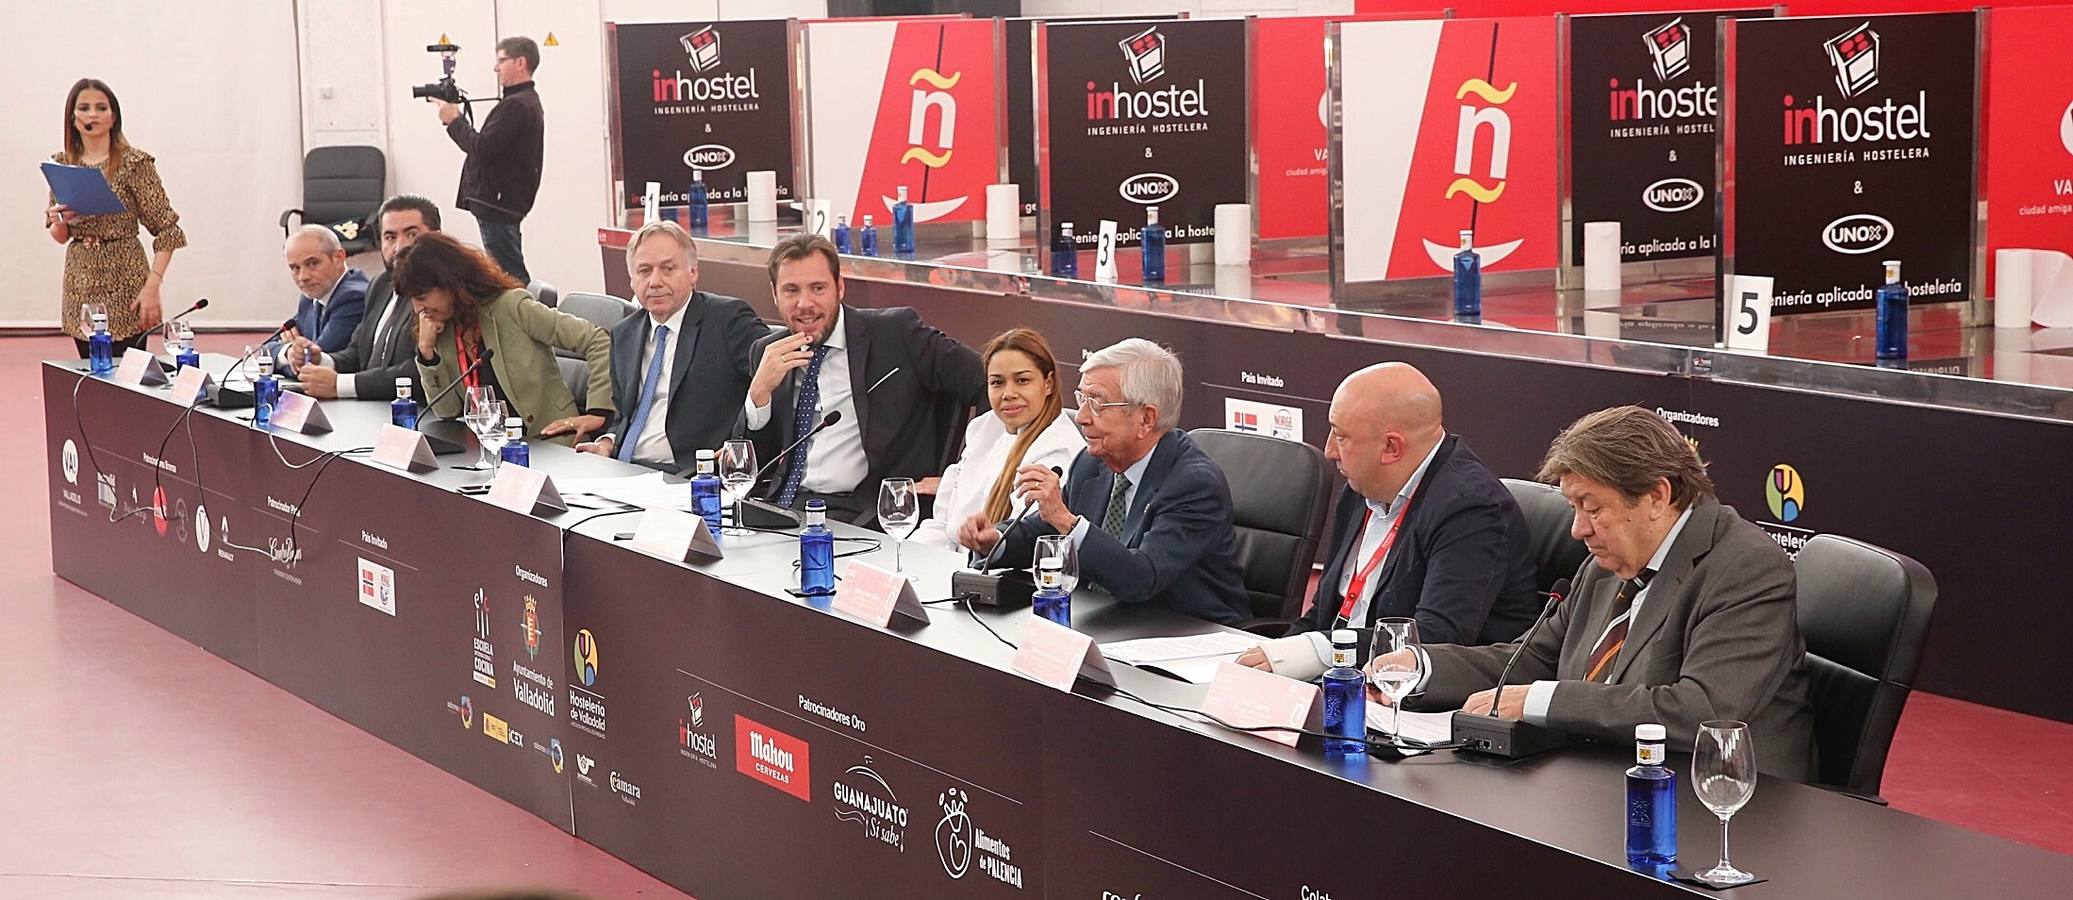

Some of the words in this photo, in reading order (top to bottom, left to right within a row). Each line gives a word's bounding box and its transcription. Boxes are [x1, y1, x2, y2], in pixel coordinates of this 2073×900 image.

[653, 68, 759, 102] inhostel
[711, 103, 759, 112] HOSTELERA
[1087, 79, 1208, 119] inhostel
[1610, 78, 1717, 120] inhoste
[1783, 90, 1930, 144] inhostel
[705, 124, 712, 133] &
[1088, 124, 1146, 136] INGENIERÍA
[1152, 123, 1208, 133] HOSTELERA
[1611, 124, 1670, 138] INGENIERÍA
[1676, 123, 1715, 134] HOSTEL
[690, 152, 726, 163] UNOX
[1145, 148, 1152, 158] &
[1668, 150, 1677, 161] &
[1784, 150, 1855, 166] INGENIERÍA
[1863, 148, 1930, 162] HOSTELERA
[733, 187, 742, 198] la
[1127, 182, 1169, 196] UNOX
[1651, 188, 1693, 202] UNOX
[1854, 181, 1863, 194] &
[2020, 204, 2046, 215] ciudad
[1175, 226, 1185, 237] la
[1831, 225, 1882, 243] UNOX
[1101, 233, 1109, 266] 3
[1639, 237, 1686, 256] aplicada
[1689, 240, 1696, 249] a
[1700, 235, 1710, 249] la
[1816, 284, 1873, 306] aplicada
[1737, 291, 1758, 335] 5
[1257, 373, 1284, 388] Invitado
[1656, 407, 1719, 427] Organizadores
[515, 564, 548, 588] Organizadores
[513, 660, 546, 687] Ayuntamiento
[513, 677, 555, 717] Valladolid
[569, 689, 605, 717] Hostelería
[570, 707, 578, 721] de
[798, 694, 851, 726] Patrocinadores
[851, 714, 866, 732] Oro
[750, 731, 793, 773] Mahou
[755, 762, 789, 784] CERVEZAS
[833, 781, 907, 827] GUANAJUATO
[975, 827, 1010, 861] Alimentos
[979, 855, 987, 870] de
[987, 857, 1023, 890] PALENCIA
